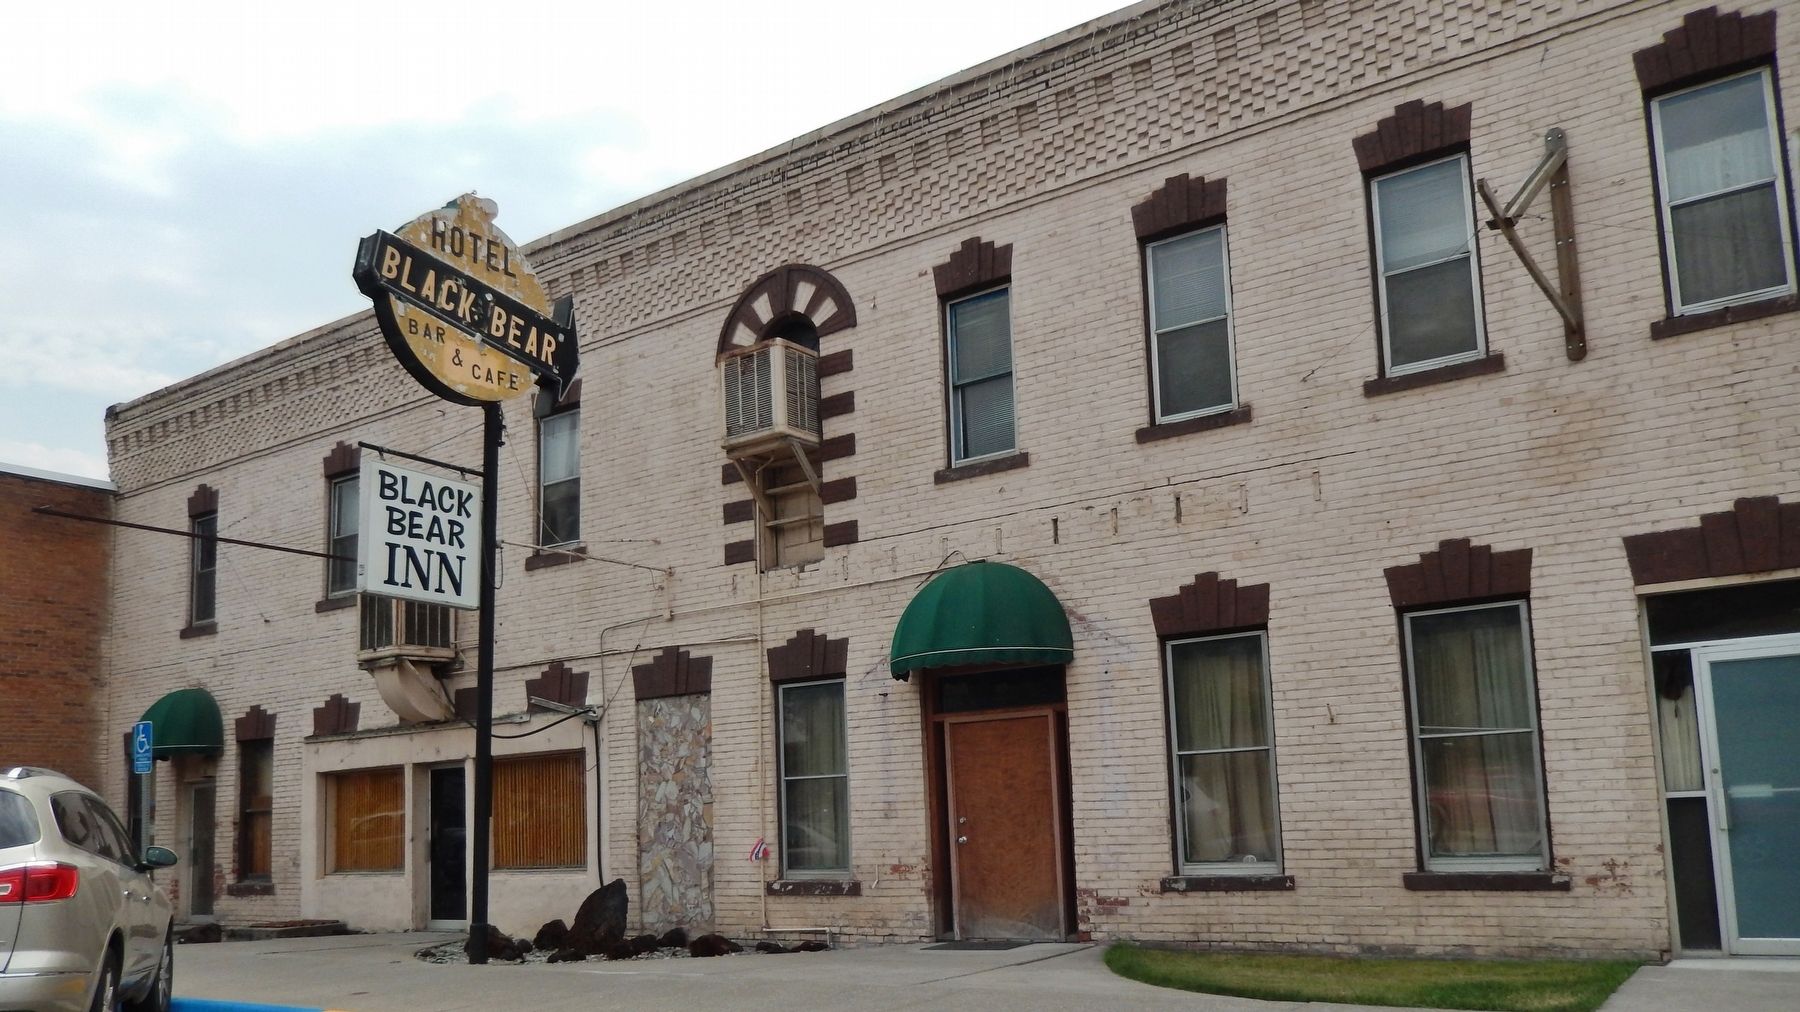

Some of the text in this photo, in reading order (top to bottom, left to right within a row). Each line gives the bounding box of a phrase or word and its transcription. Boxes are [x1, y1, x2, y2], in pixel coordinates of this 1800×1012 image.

[431, 217, 517, 279] HOTEL
[381, 245, 557, 367] BLACK BEAR
[408, 319, 519, 391] BAR & CAFE
[378, 469, 474, 519] BLACK
[385, 505, 465, 549] BEAR
[383, 541, 466, 597] INN
